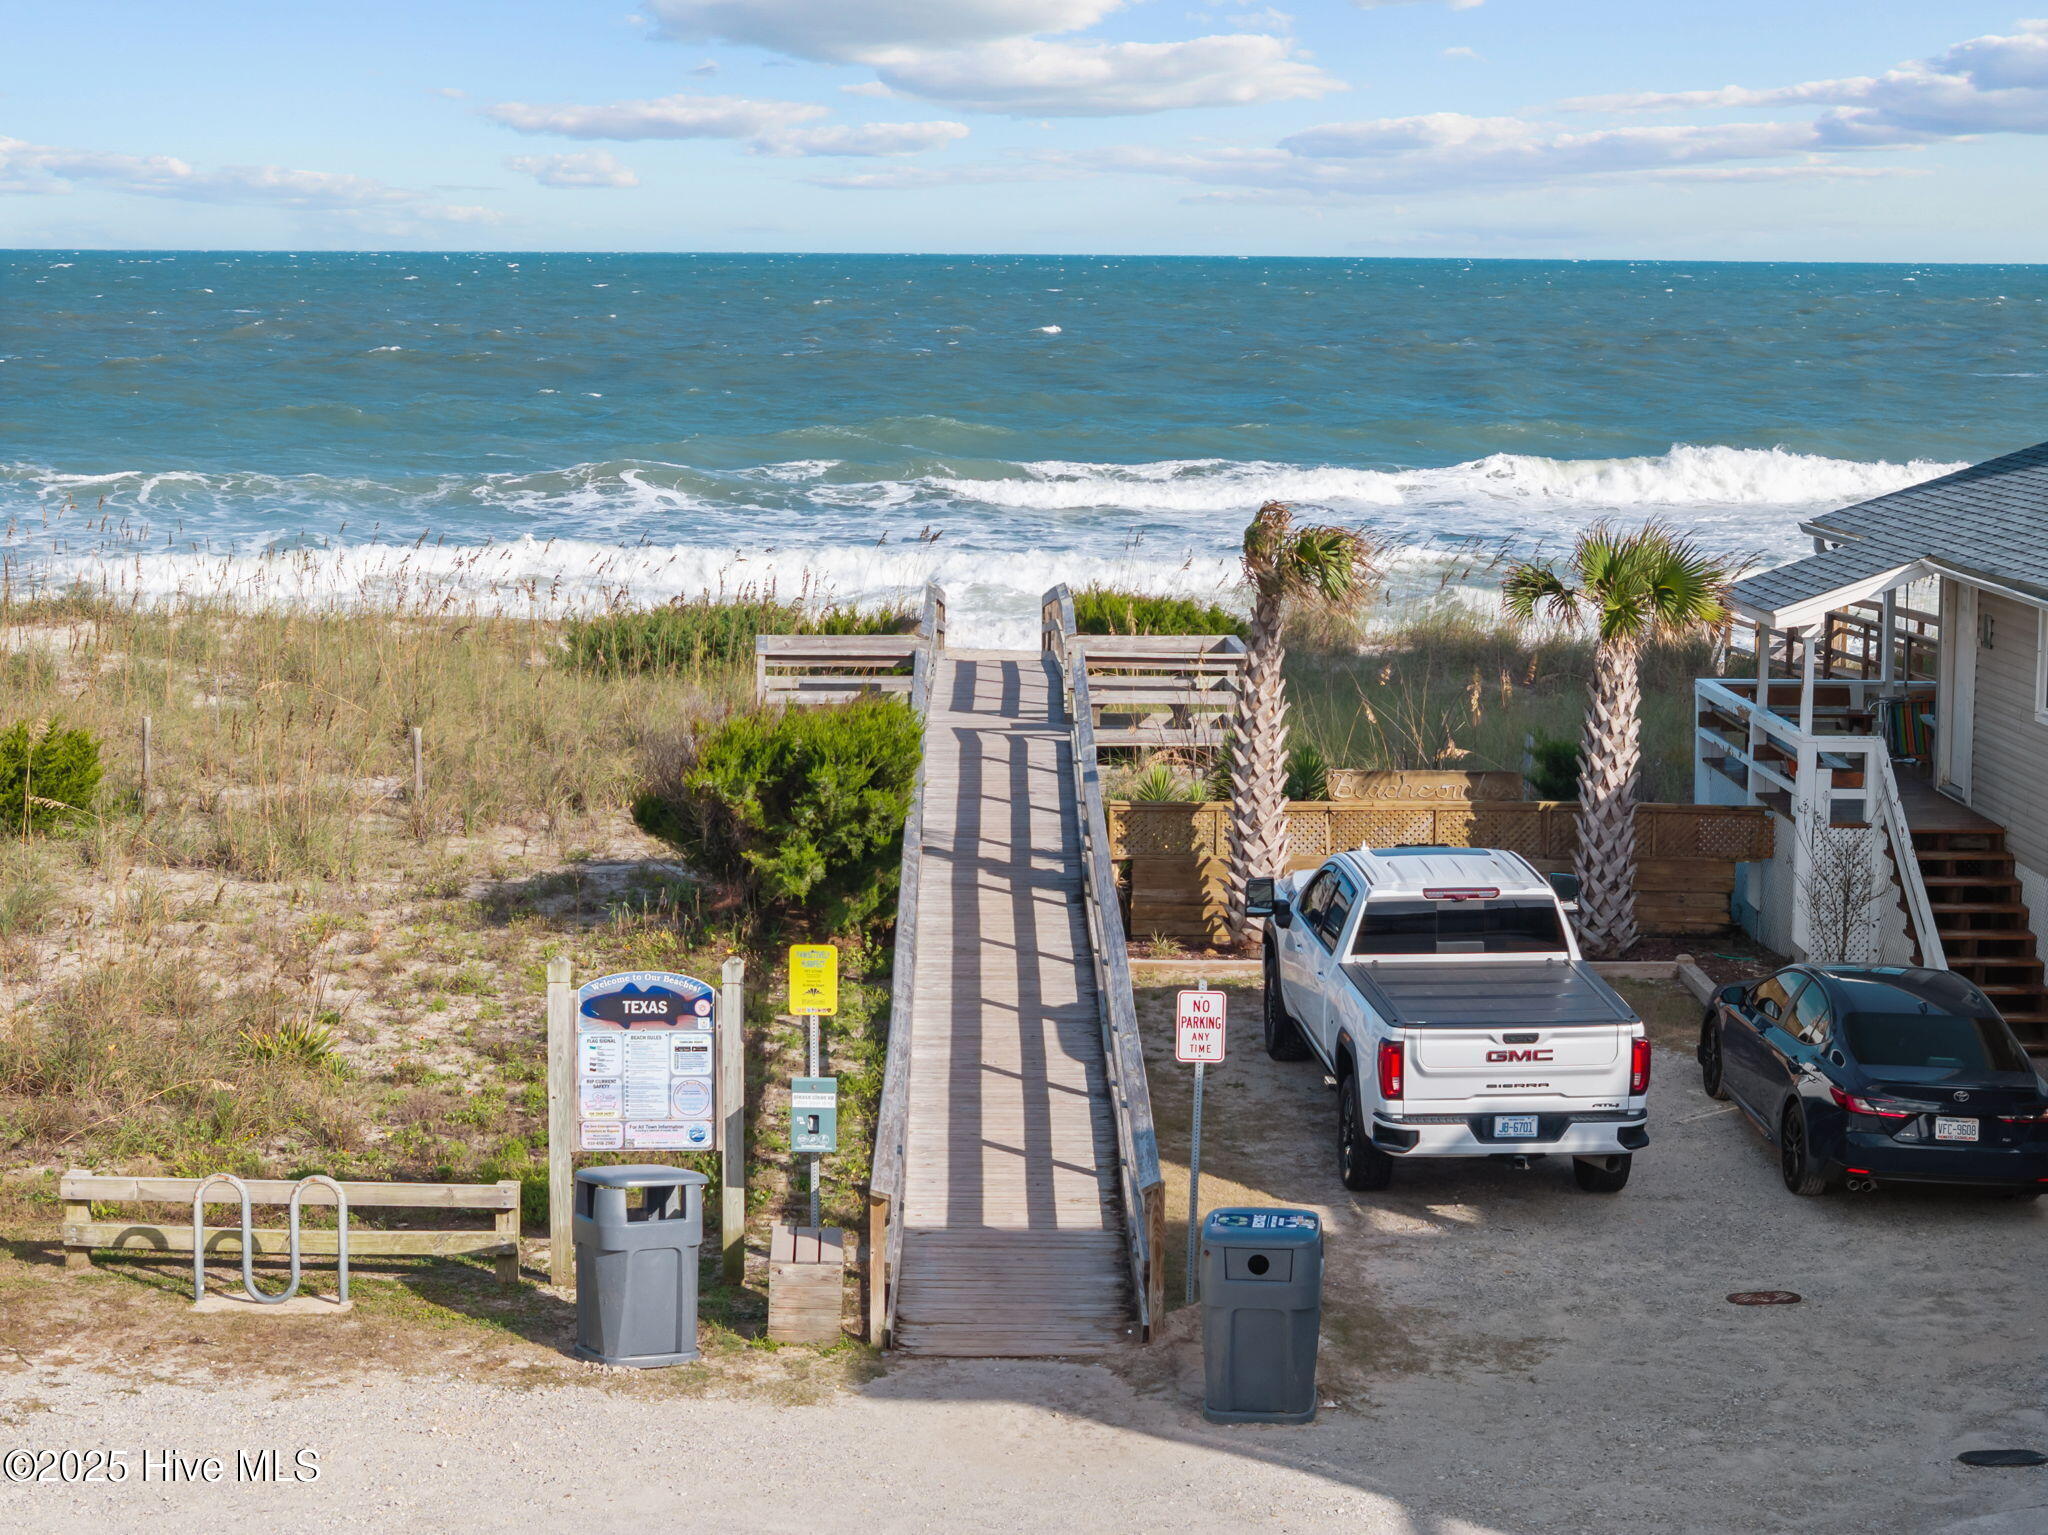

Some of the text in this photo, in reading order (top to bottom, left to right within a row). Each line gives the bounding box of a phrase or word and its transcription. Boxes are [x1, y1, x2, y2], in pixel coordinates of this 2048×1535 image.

[591, 976, 630, 991] Welcome
[644, 973, 660, 981] Our
[664, 975, 701, 993] Beaches!
[622, 1000, 668, 1014] TEXAS
[1193, 1000, 1210, 1012] NO
[1181, 1016, 1221, 1030] PARKING
[1192, 1032, 1210, 1041] ANY
[1190, 1044, 1212, 1053] TIME
[1486, 1049, 1553, 1062] GMC
